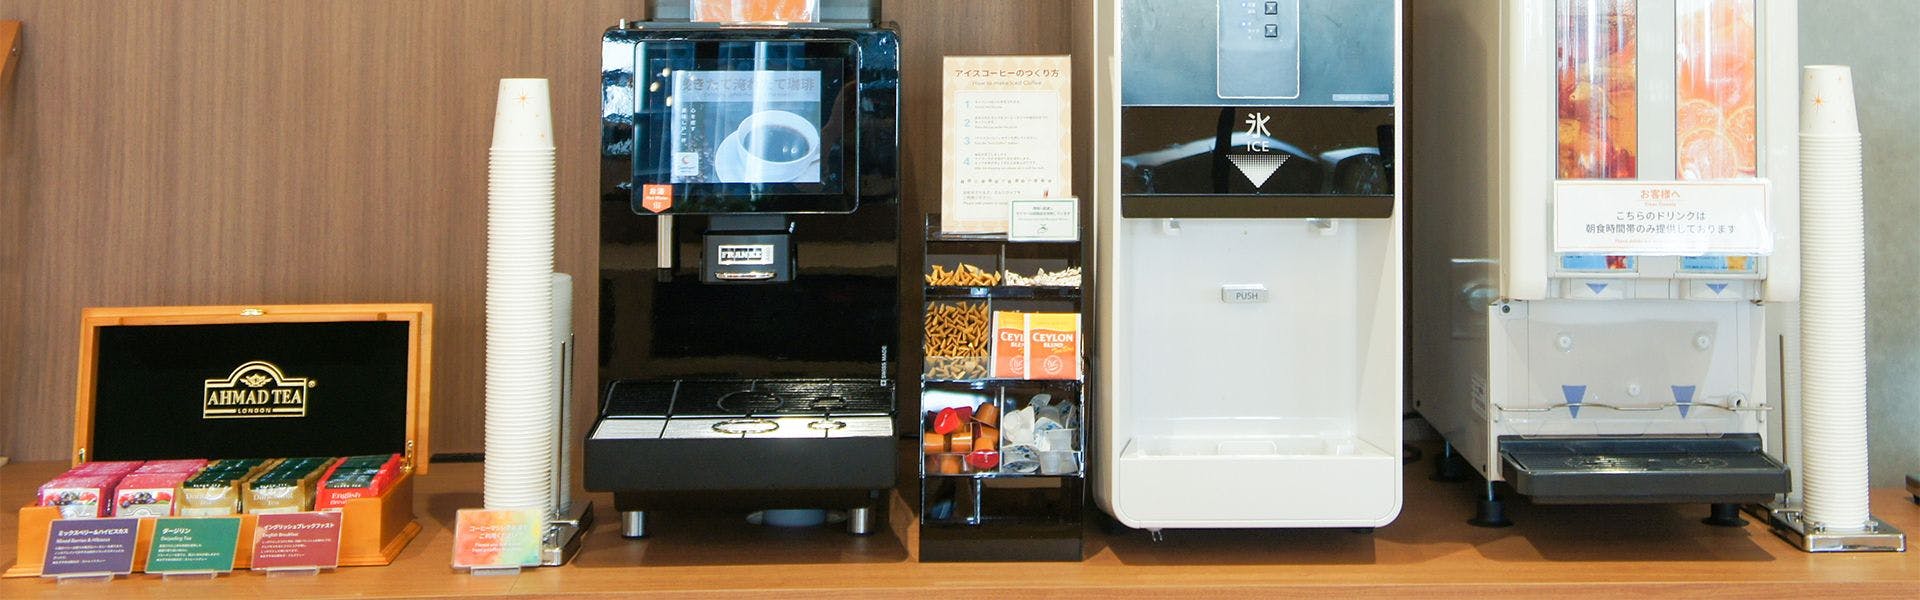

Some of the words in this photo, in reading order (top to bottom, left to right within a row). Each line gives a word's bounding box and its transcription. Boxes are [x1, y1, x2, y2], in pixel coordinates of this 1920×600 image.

[955, 69, 1060, 78] アイスコーヒーのつくり方
[964, 100, 970, 108] 1
[963, 119, 972, 128] 2
[1245, 112, 1271, 138] 氷
[963, 137, 971, 146] 3
[1247, 141, 1270, 152] ICE
[1640, 189, 1681, 200] お客様へ
[1616, 211, 1705, 221] こちらのドリンクは
[1586, 223, 1736, 234] 朝食時間帯のみ提供しております
[721, 249, 762, 260] FRANKE
[1236, 292, 1258, 300] PUSH
[1000, 332, 1024, 342] CEYL
[1032, 332, 1074, 342] CEYLON
[208, 389, 270, 406] AHMAD
[272, 389, 302, 404] TEA
